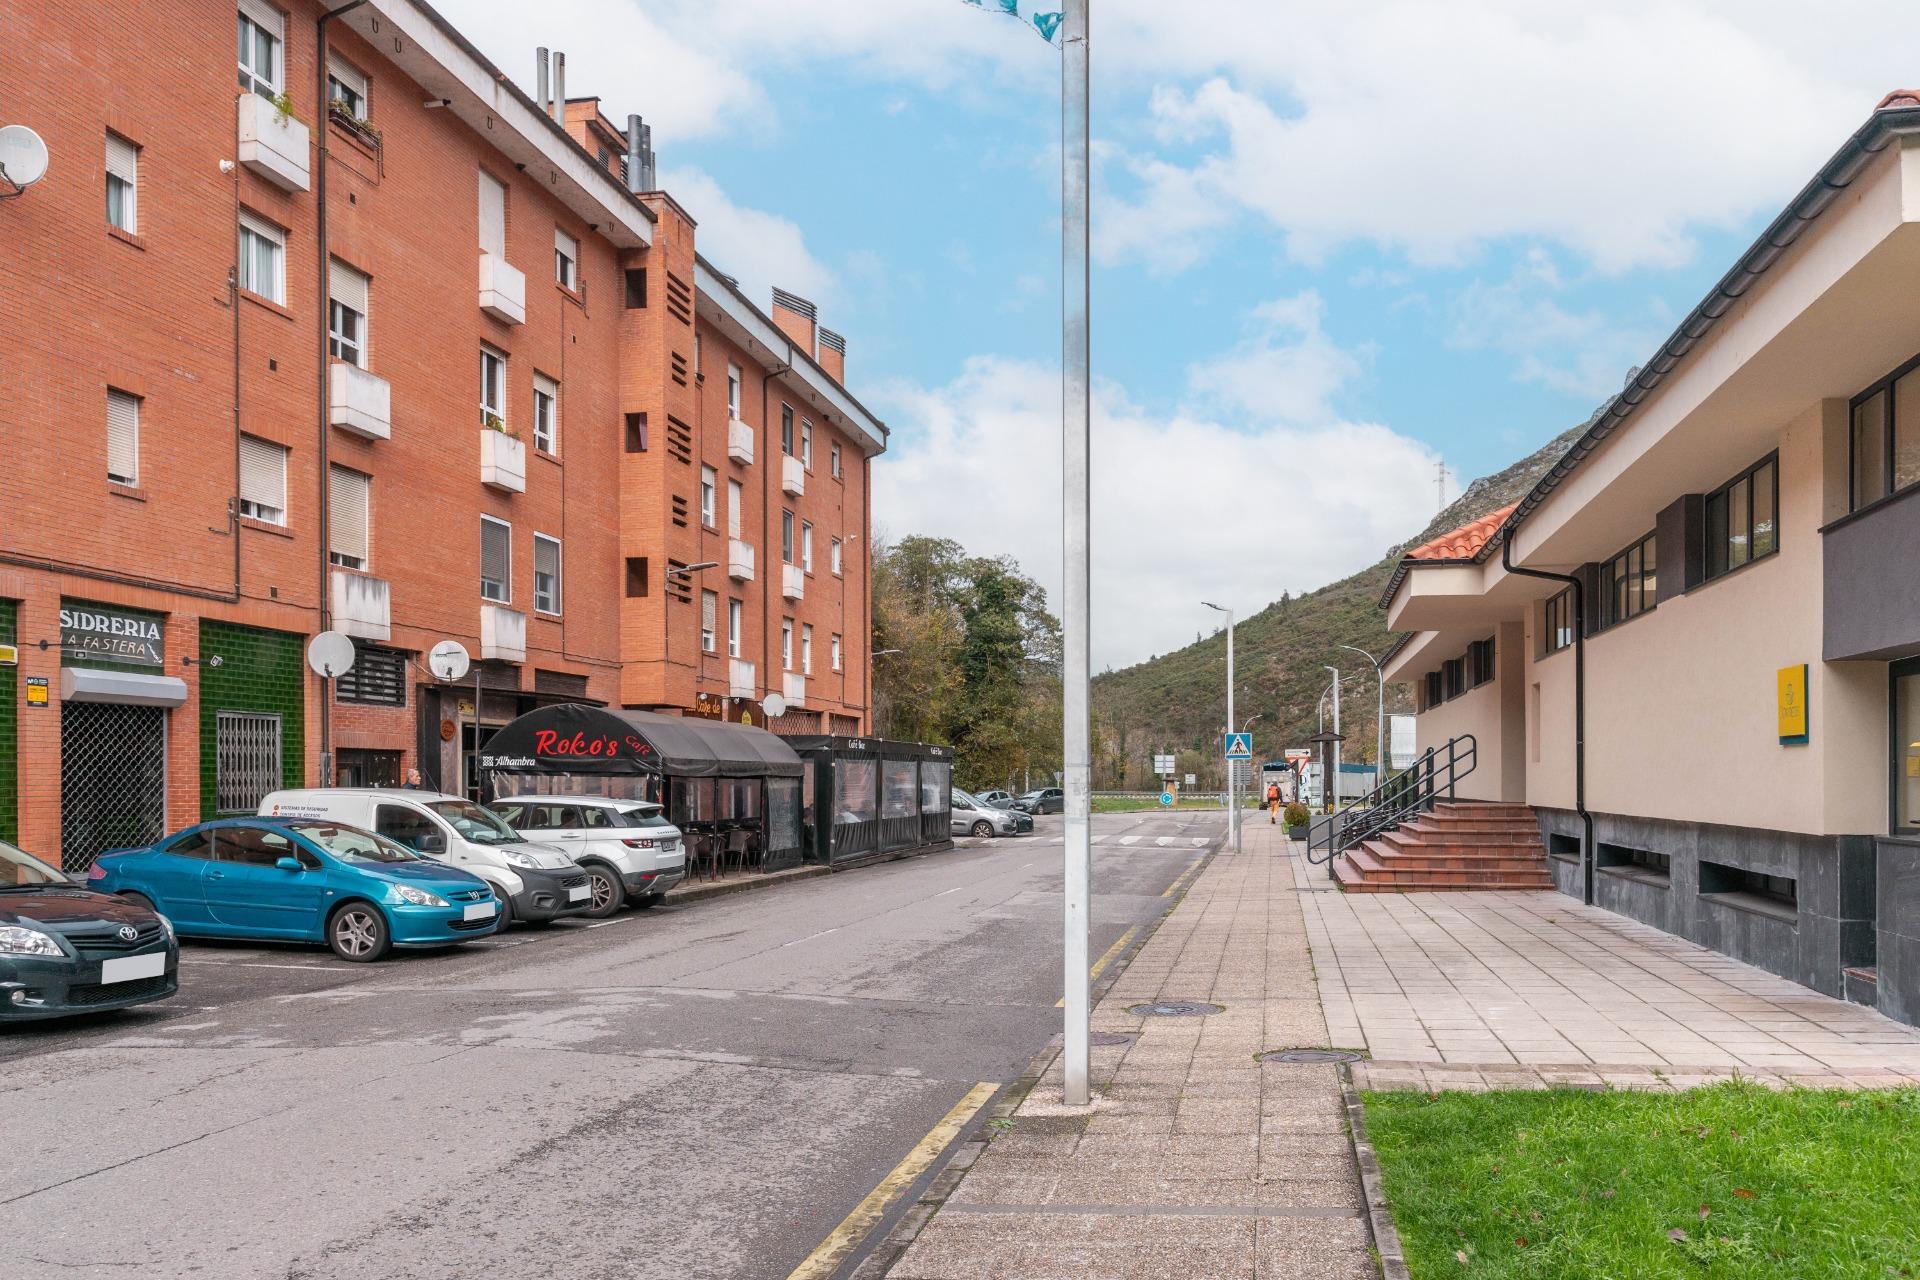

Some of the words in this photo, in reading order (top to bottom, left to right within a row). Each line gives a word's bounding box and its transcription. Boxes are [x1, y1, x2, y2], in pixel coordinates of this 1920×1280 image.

[60, 609, 160, 640] SIDRERIA
[60, 634, 76, 645] A
[83, 636, 145, 655] FASTERA
[535, 730, 618, 757] Roko's
[495, 756, 536, 767] Alhambra
